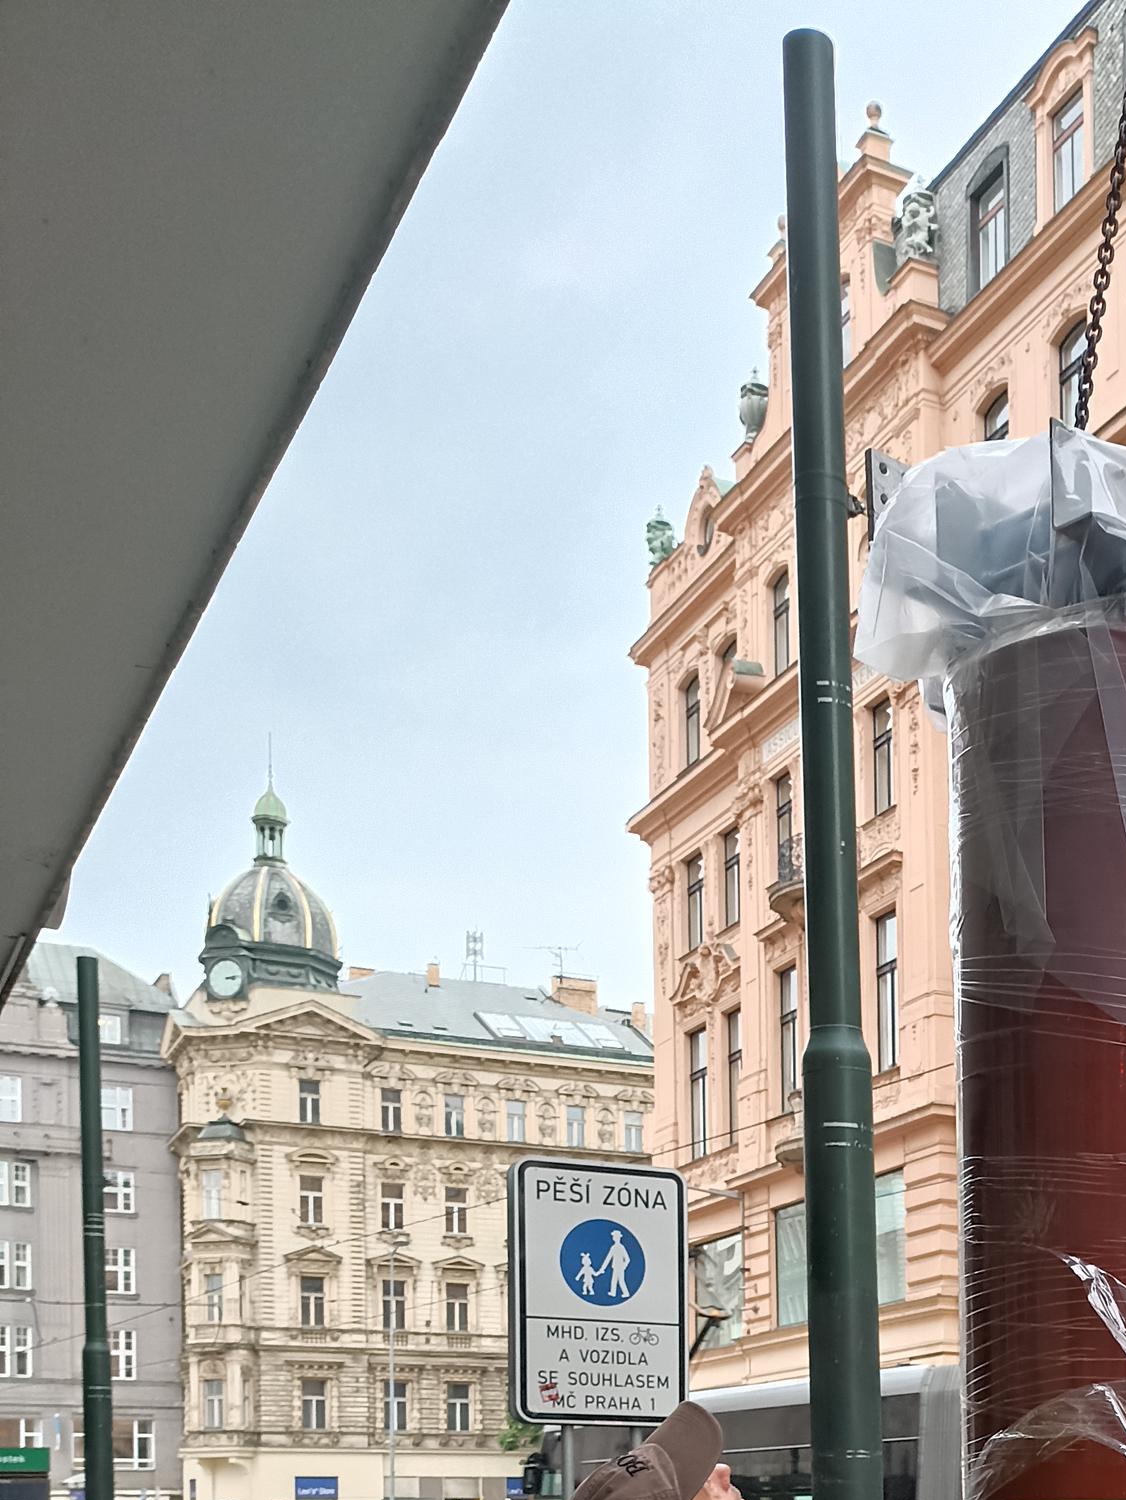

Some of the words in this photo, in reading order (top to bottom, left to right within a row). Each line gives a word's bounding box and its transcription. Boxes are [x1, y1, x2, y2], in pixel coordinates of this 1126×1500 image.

[536, 1176, 592, 1204] PĚŠÍ
[603, 1182, 668, 1211] ZÓNA
[558, 1349, 569, 1363] A
[579, 1349, 648, 1366] VOZIDLA
[537, 1370, 558, 1385] SE
[568, 1371, 668, 1389] SOUHLASEM
[552, 1391, 575, 1409] MČ
[585, 1394, 642, 1411] PRAHA
[650, 1396, 656, 1411] 1
